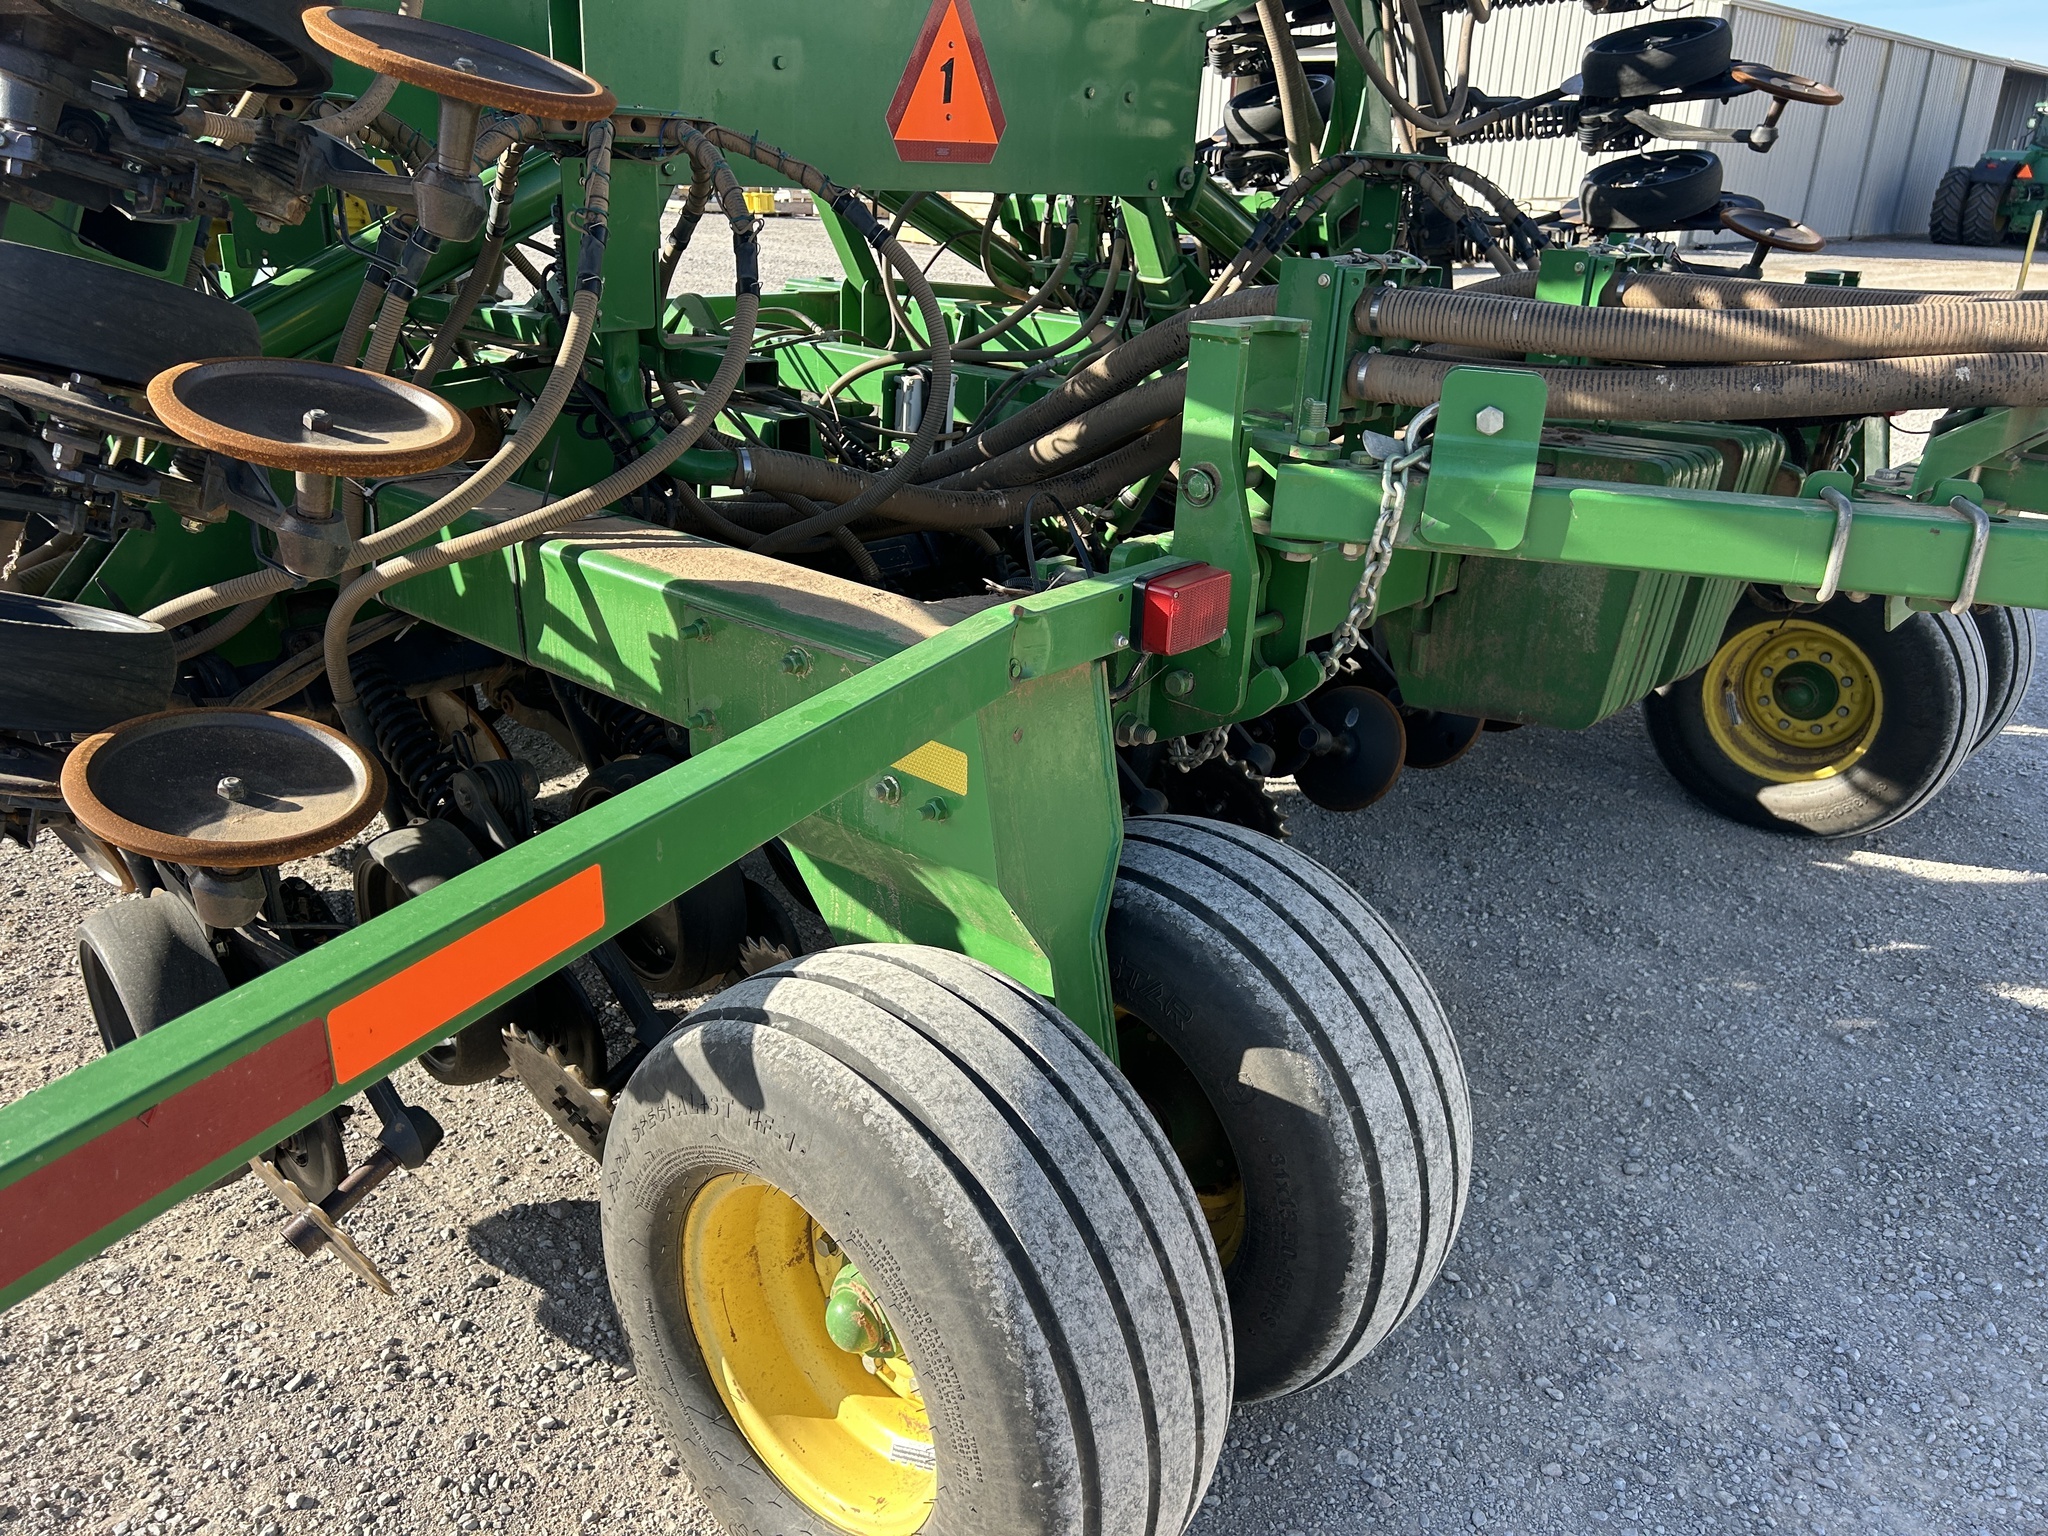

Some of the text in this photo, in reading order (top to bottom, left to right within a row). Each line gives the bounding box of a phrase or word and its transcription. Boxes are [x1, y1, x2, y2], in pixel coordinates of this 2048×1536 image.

[940, 57, 955, 104] 1
[631, 1093, 734, 1142] SPECIALIST
[747, 1105, 797, 1153] HF-1
[918, 1331, 931, 1353] LOAD
[929, 1327, 945, 1351] PLY
[942, 1354, 966, 1401] RATING
[908, 1304, 939, 1356] INFLATION
[962, 1437, 972, 1461] COLD
